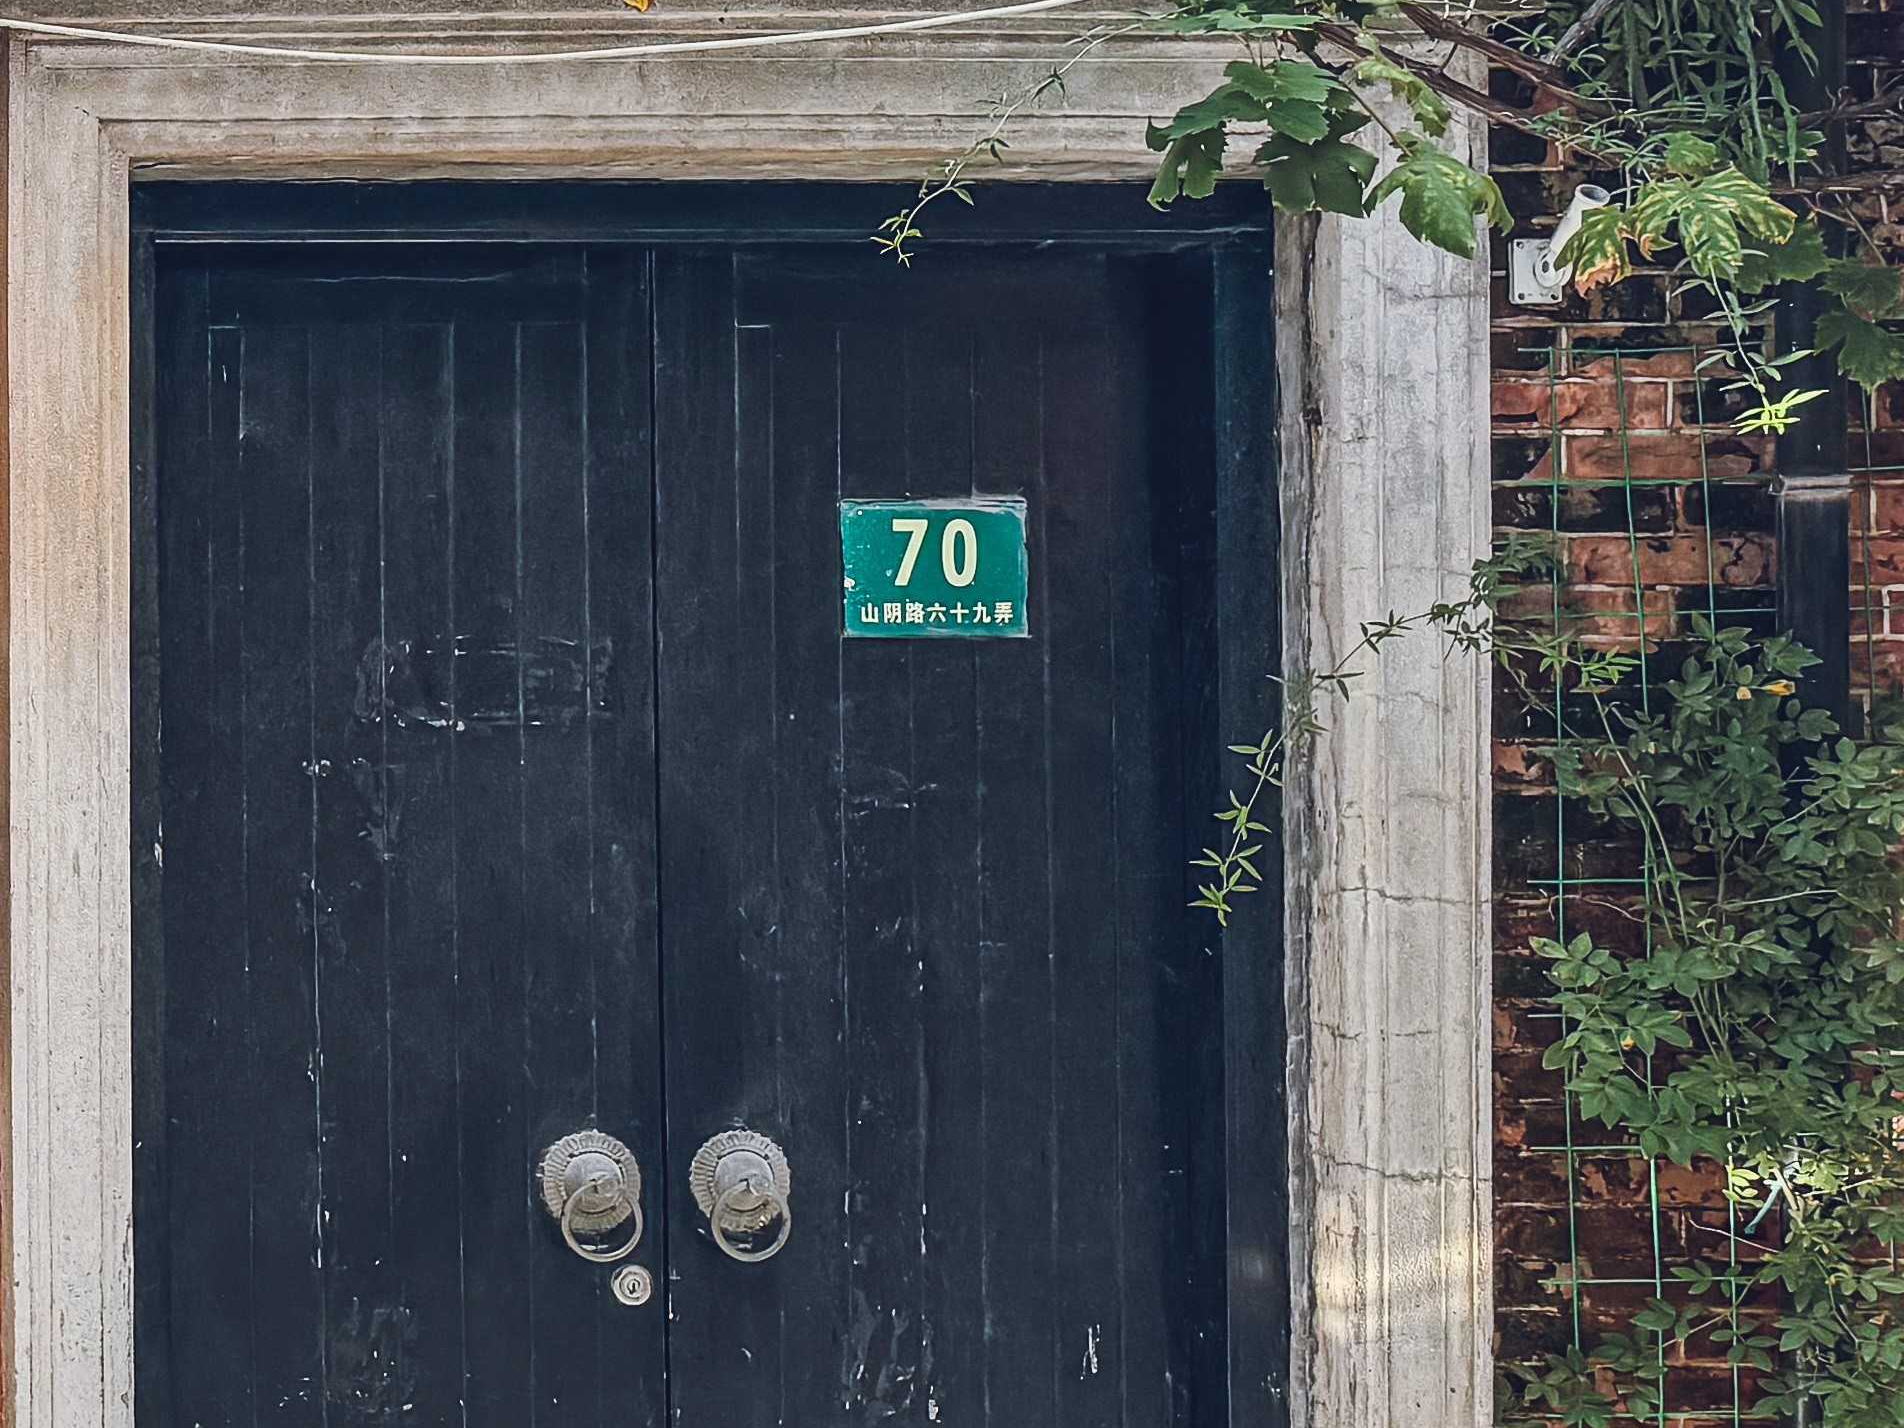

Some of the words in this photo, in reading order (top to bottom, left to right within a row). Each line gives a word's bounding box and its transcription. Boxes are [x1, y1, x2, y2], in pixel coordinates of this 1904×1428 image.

[891, 518, 978, 587] 70
[860, 601, 1014, 624] 山阴路六十九弄
